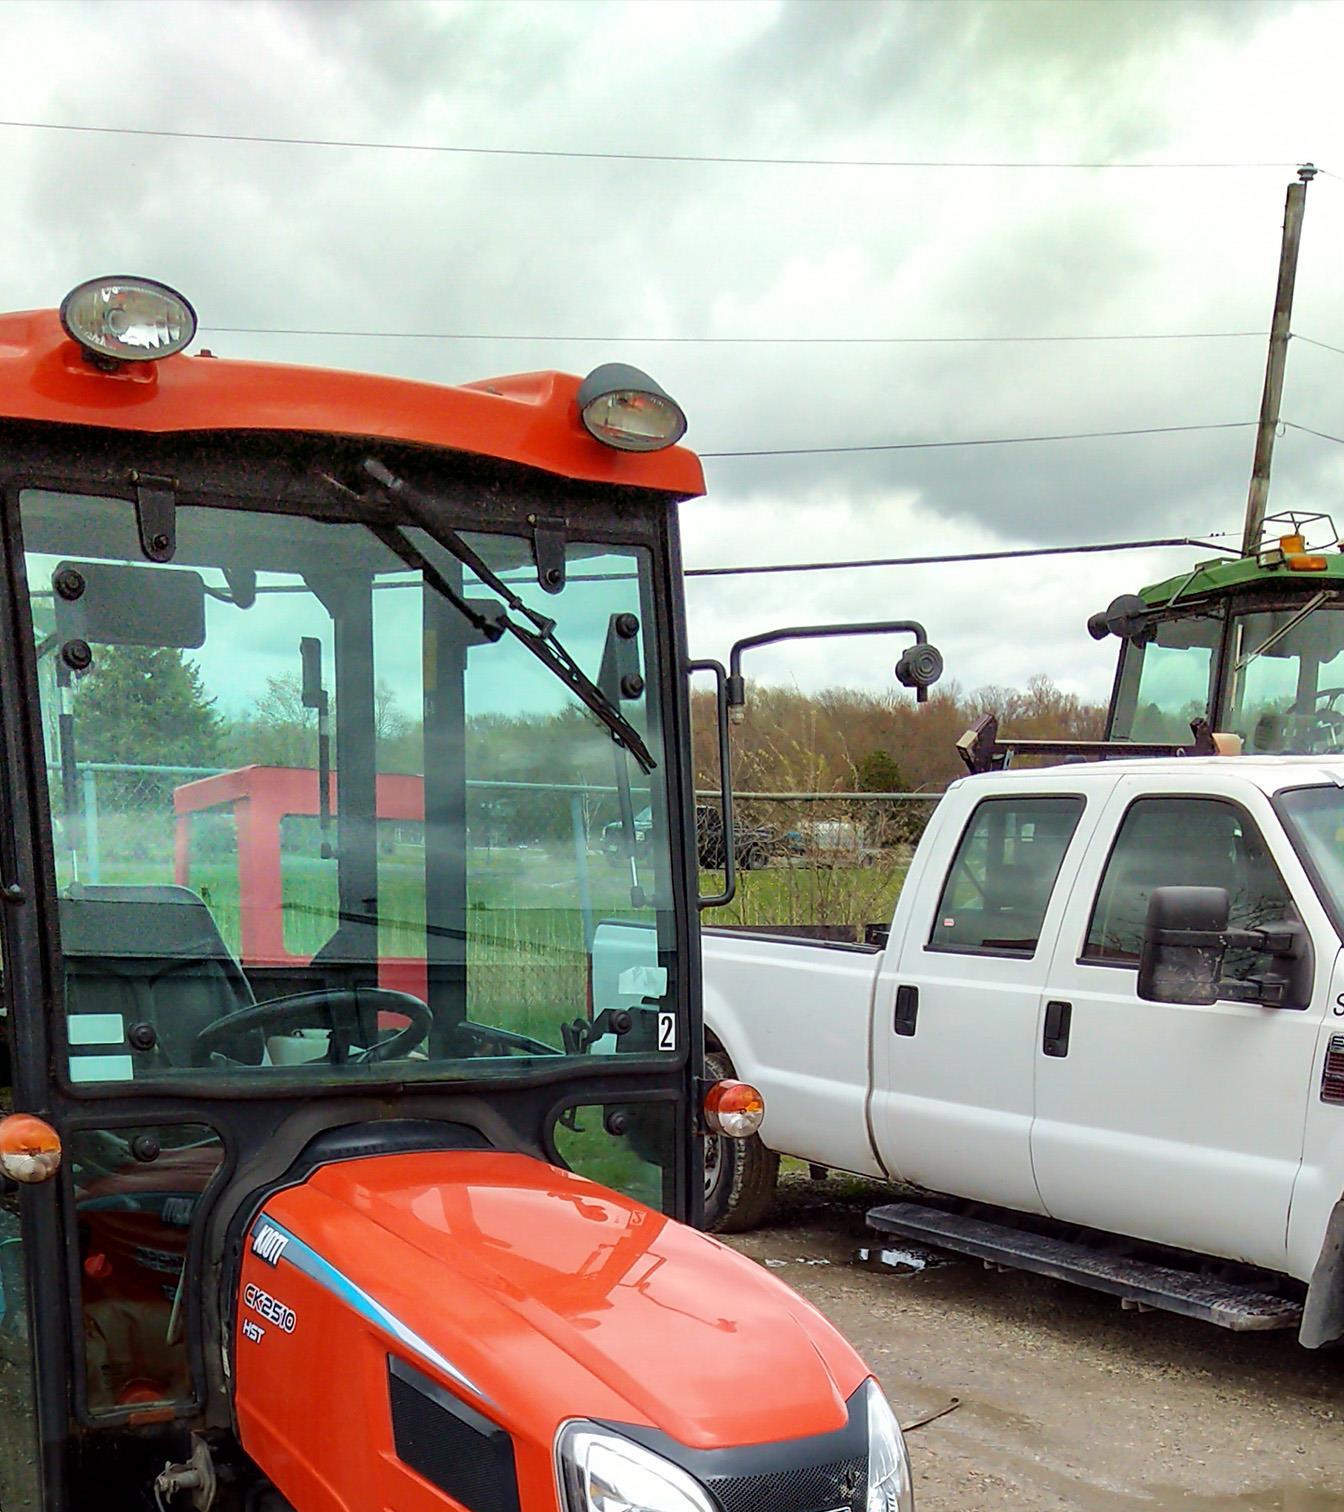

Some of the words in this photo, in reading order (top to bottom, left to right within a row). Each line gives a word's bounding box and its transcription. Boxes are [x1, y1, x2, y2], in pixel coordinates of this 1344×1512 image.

[660, 1015, 673, 1048] 2
[252, 1223, 289, 1265] KIOTI
[243, 1283, 297, 1334] CK2510
[242, 1319, 266, 1345] HST
